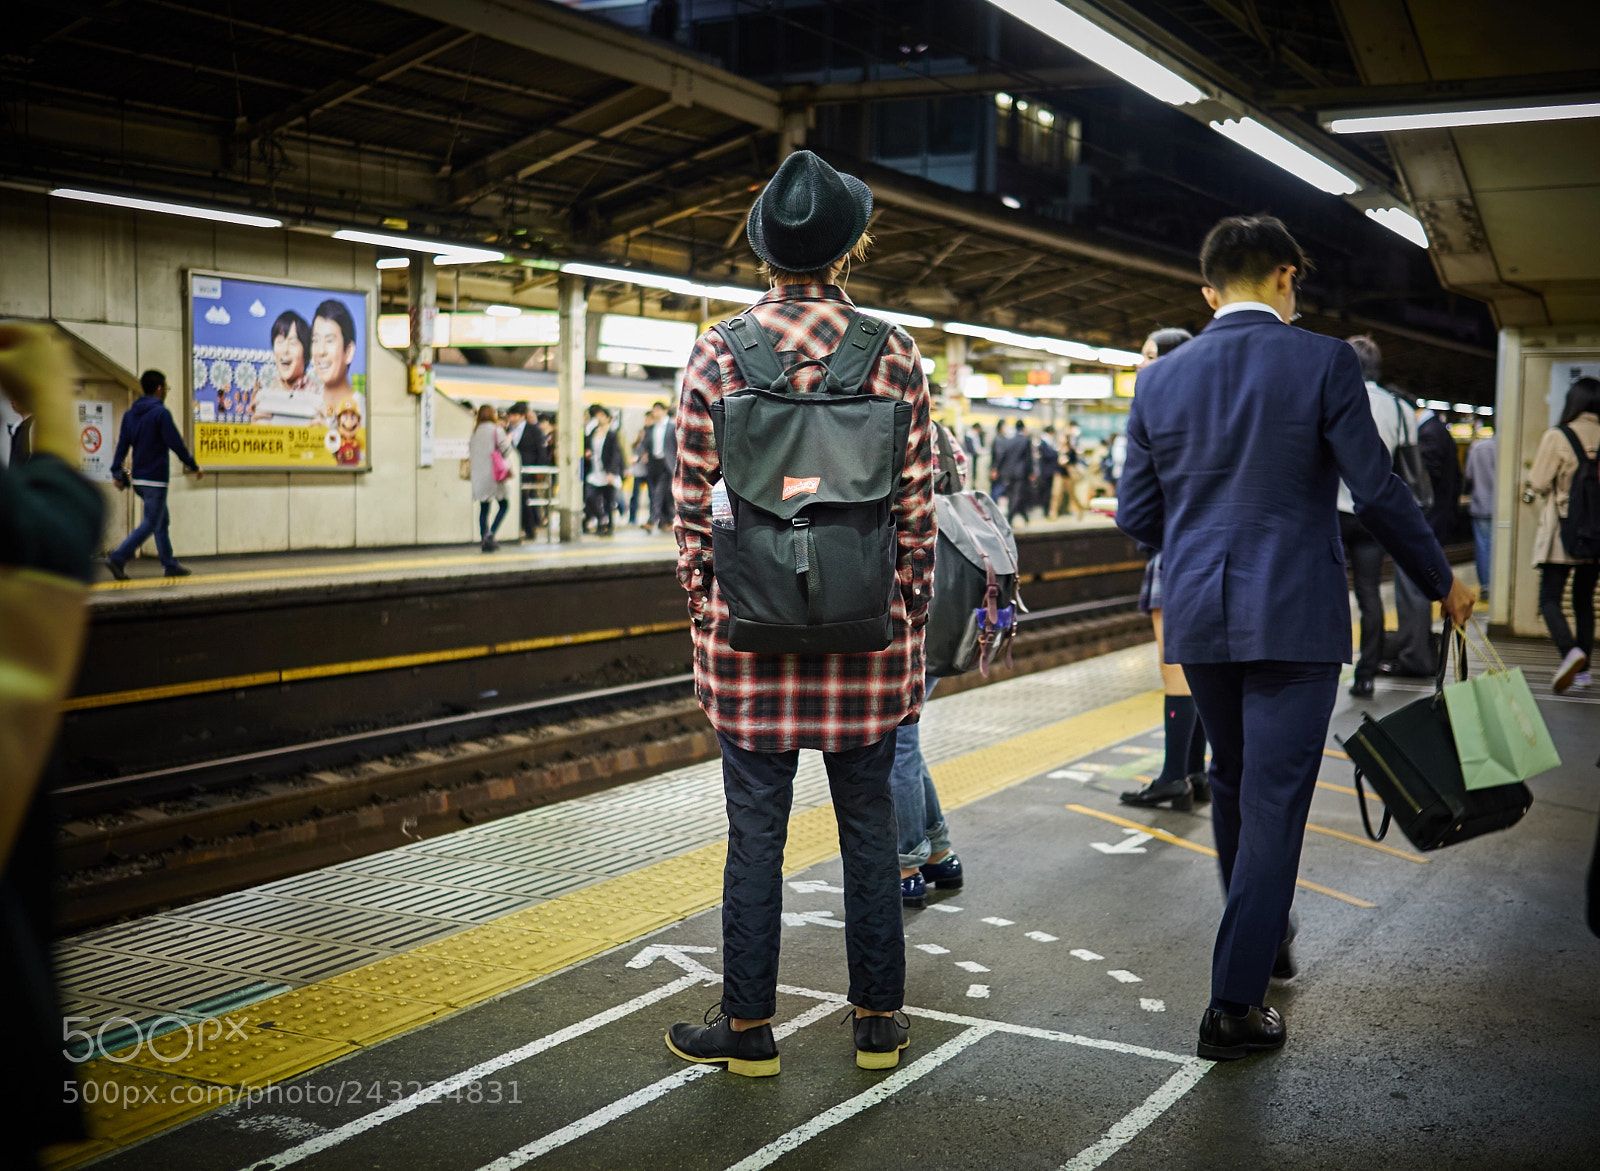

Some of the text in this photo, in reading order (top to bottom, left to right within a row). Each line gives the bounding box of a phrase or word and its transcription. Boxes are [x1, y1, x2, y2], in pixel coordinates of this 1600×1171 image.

[200, 426, 229, 437] SUPER
[200, 438, 240, 453] MARIO
[243, 438, 283, 454] MAKER
